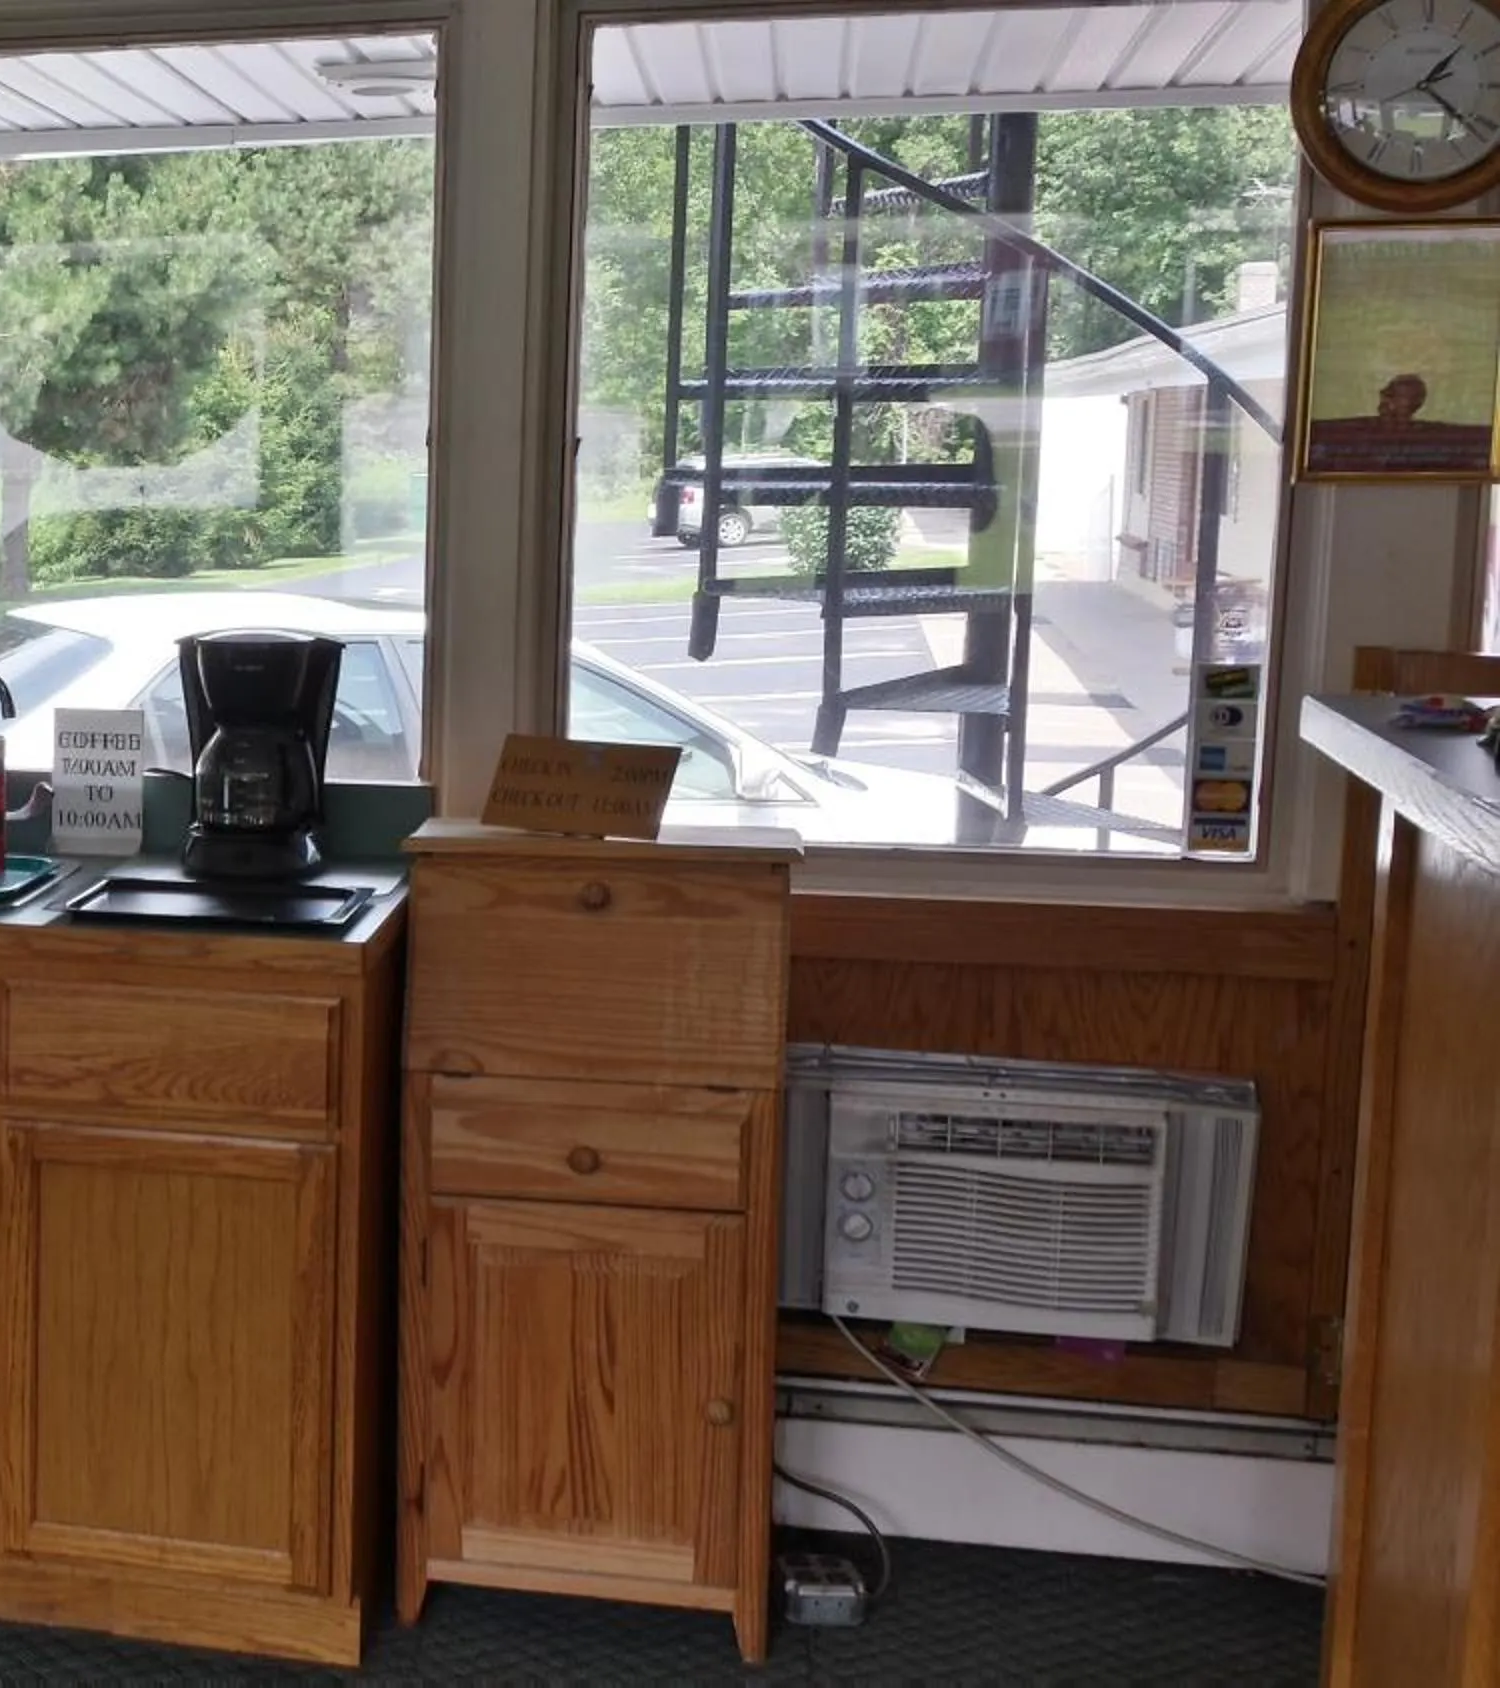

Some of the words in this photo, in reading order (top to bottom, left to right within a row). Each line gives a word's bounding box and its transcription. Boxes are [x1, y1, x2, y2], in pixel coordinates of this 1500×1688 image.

[58, 731, 141, 750] COFFEE
[83, 783, 114, 802] TO
[58, 808, 142, 830] 10:00AM
[1200, 827, 1237, 840] VISA
